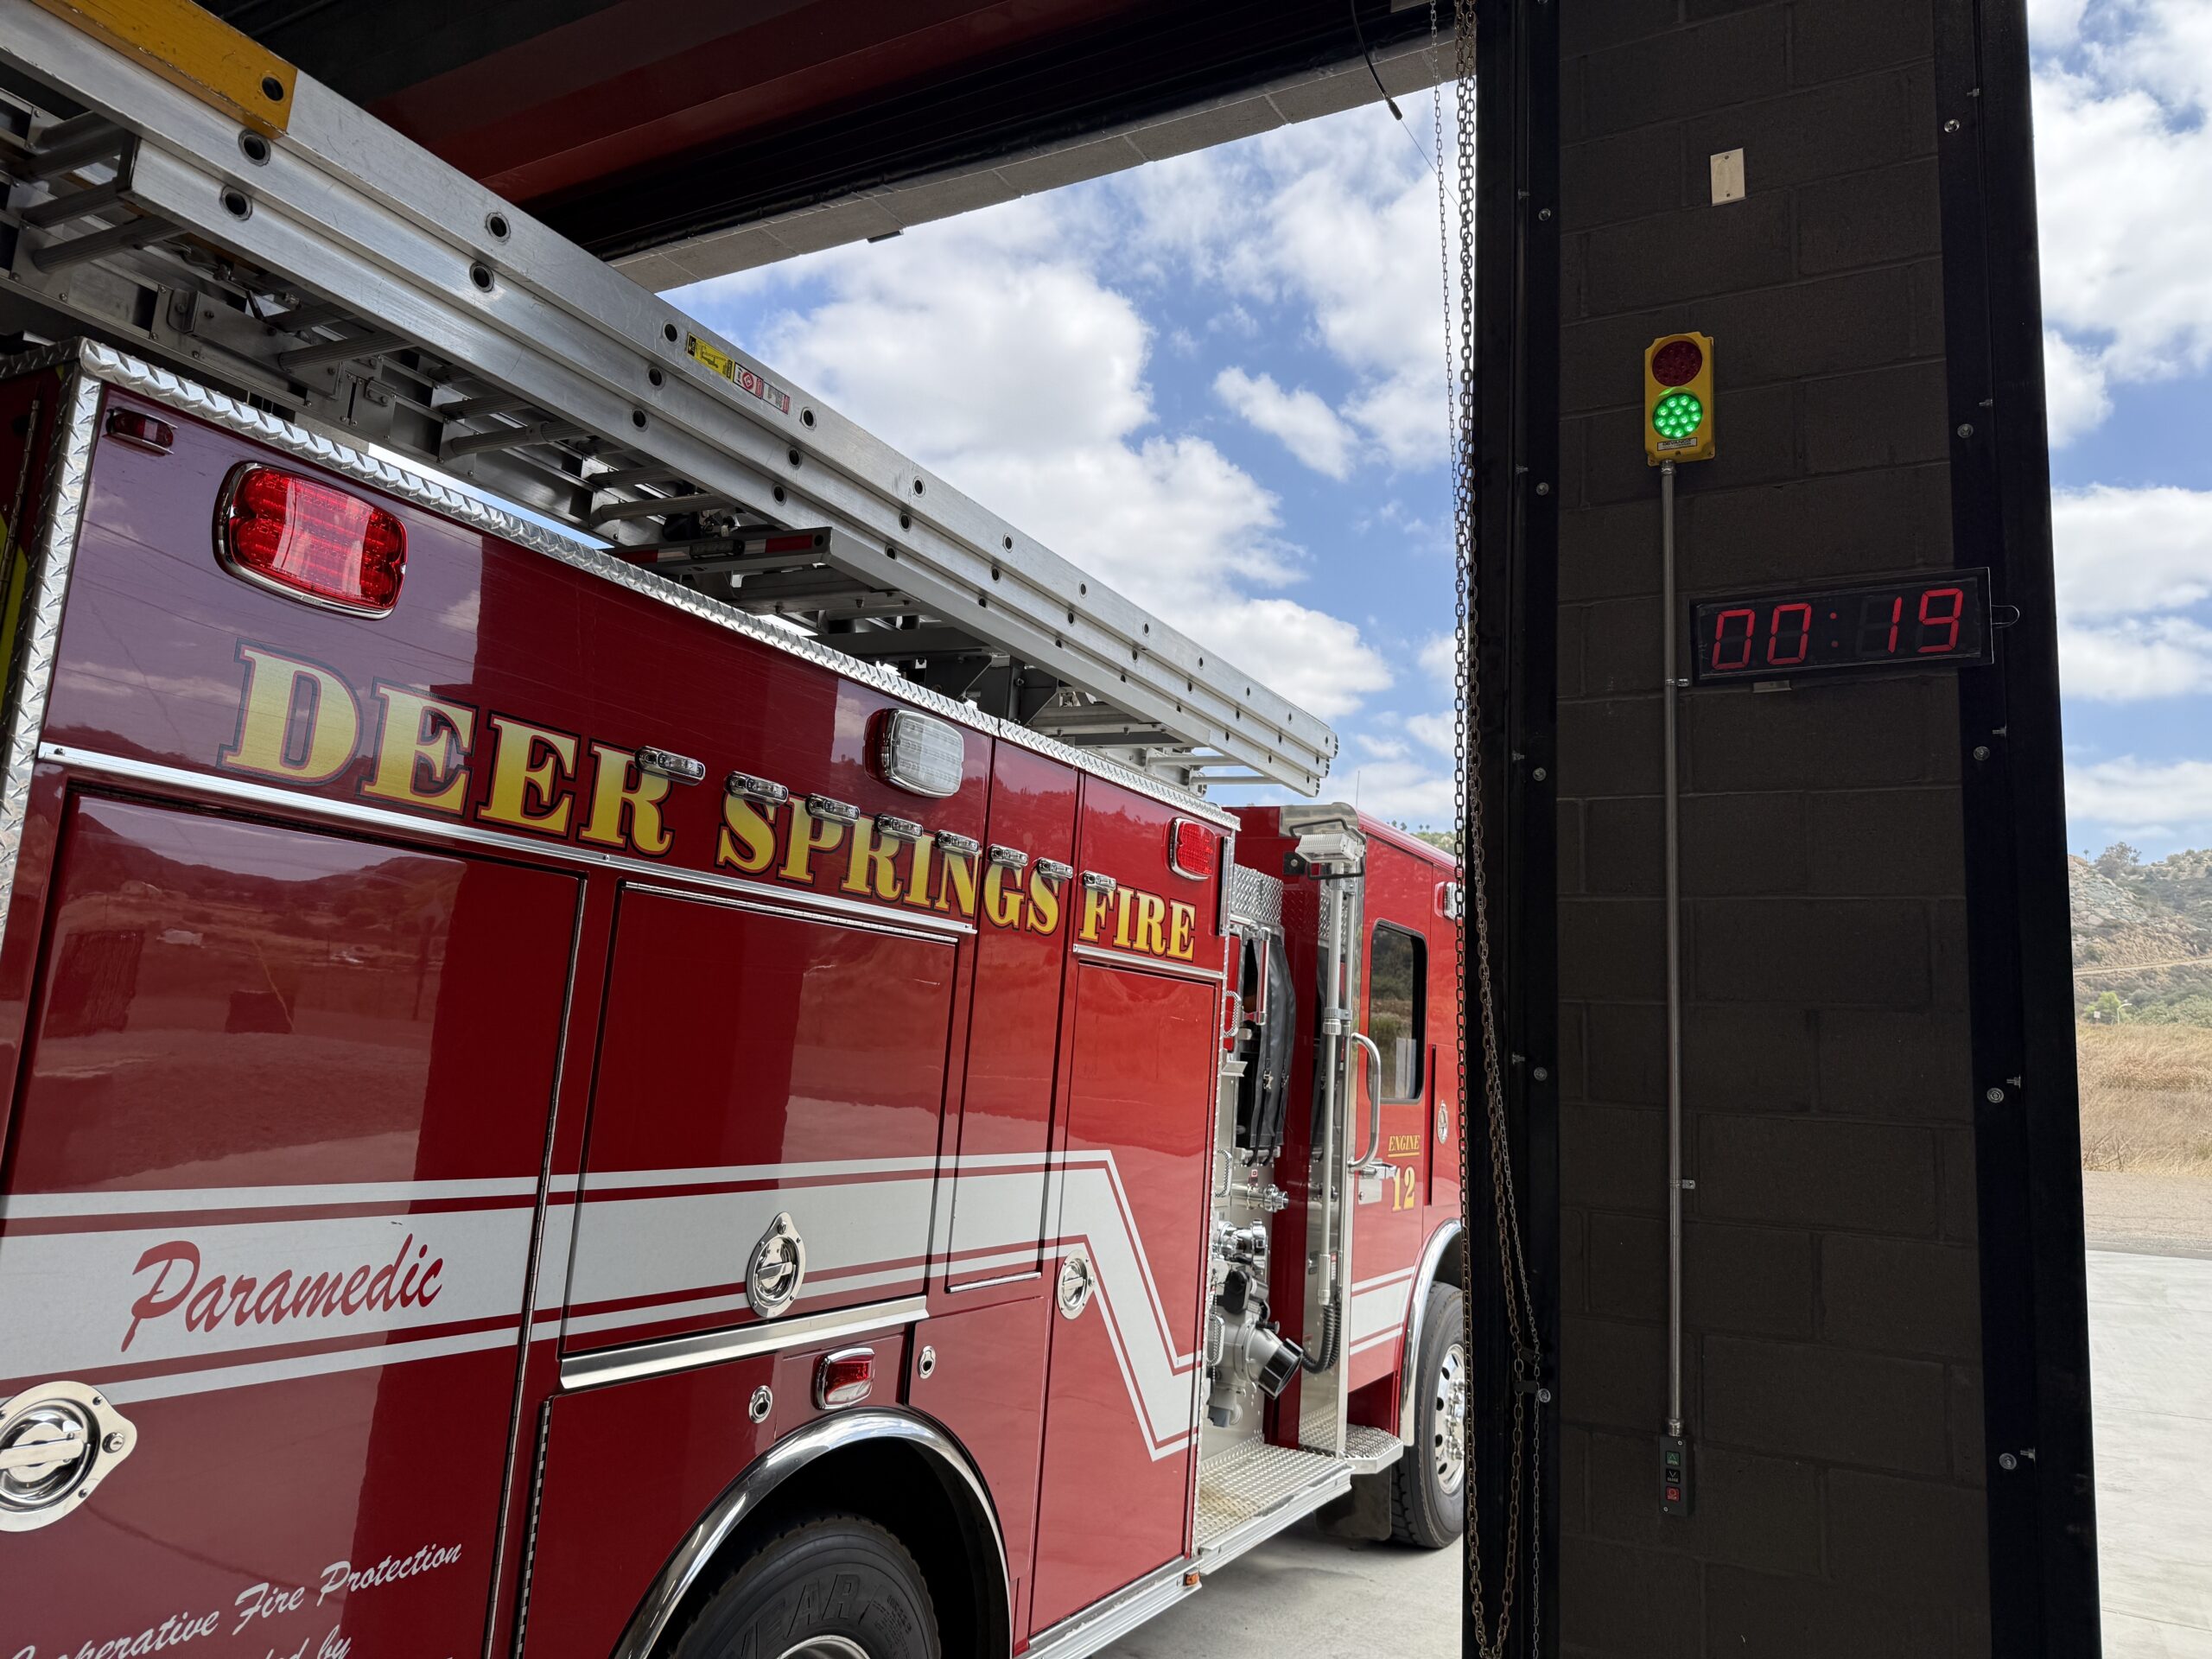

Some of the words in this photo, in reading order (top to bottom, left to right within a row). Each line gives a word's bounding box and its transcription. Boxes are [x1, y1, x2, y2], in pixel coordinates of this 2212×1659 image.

[216, 638, 677, 859] DEER
[714, 788, 1063, 936] SPRINGS
[1077, 880, 1197, 963] FIRE
[1388, 1135, 1421, 1152] ENGINE
[1392, 1165, 1416, 1212] 12
[121, 1233, 443, 1352] Paramedic
[231, 1582, 306, 1636] Fire
[316, 1543, 462, 1607] Protection
